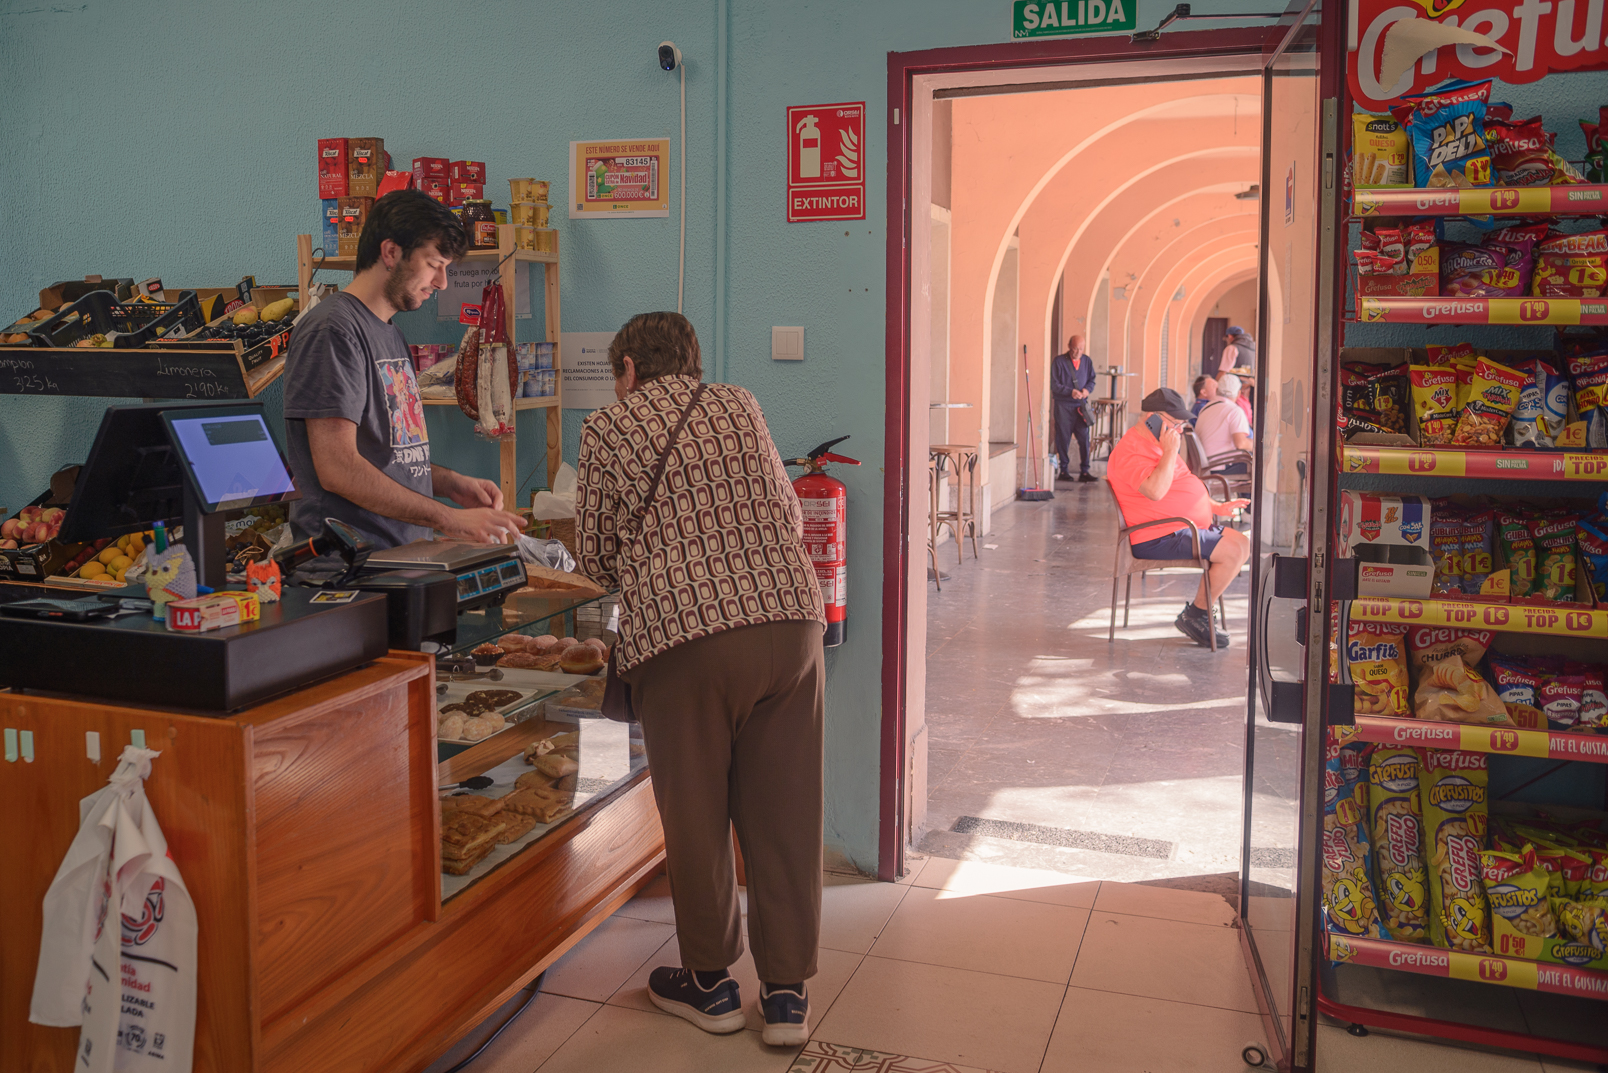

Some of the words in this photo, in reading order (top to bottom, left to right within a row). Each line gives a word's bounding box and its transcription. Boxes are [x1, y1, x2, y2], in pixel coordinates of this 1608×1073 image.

[1023, 0, 1126, 30] SALIDA
[1358, 0, 1608, 101] Grefu
[1421, 88, 1487, 116] Grefusa
[599, 145, 620, 154] NÚMERO
[621, 145, 627, 153] SE
[629, 144, 646, 153] VENDE
[647, 143, 660, 152] AQUÍ
[1369, 139, 1396, 148] QUESO
[625, 158, 649, 166] 83145
[620, 173, 647, 184] Navidad
[794, 195, 858, 210] EXTINTOR
[1569, 191, 1583, 200] SIN
[1482, 227, 1537, 243] refusa
[1541, 234, 1607, 254] M-BEAR
[448, 269, 458, 277] Se
[460, 269, 480, 277] ruega
[1575, 268, 1601, 283] 1€
[454, 280, 470, 288] fruta
[471, 281, 483, 289] por
[1364, 284, 1392, 293] Grefusa
[1422, 302, 1484, 319] Grefusa
[1580, 305, 1589, 314] IN
[1438, 348, 1470, 364] Grefusa
[157, 357, 217, 378] Limonera
[1422, 375, 1456, 387] Grefusa
[1484, 370, 1519, 387] Grefusa
[1433, 388, 1450, 399] MIX
[1487, 385, 1512, 398] MIX
[1440, 396, 1447, 407] 5
[1562, 427, 1582, 440] 1€
[1496, 459, 1511, 468] SIN
[1572, 461, 1608, 475] TOP
[1534, 520, 1576, 537] Grefusa
[1464, 541, 1484, 549] MIX
[1578, 539, 1603, 555] efusa
[1468, 554, 1489, 572] 1€
[1486, 577, 1505, 590] 1€
[1360, 603, 1392, 616] TOP
[1400, 602, 1420, 616] 1€
[1444, 609, 1477, 622] TOP
[1487, 608, 1507, 623] 1€
[176, 611, 192, 626] LA
[1525, 614, 1559, 628] TOP
[1568, 613, 1590, 629] 1€
[1414, 628, 1490, 648] Grefusa
[1369, 668, 1388, 677] QUESO
[1499, 674, 1536, 686] Grefusa
[1546, 684, 1582, 696] Grefusa
[1394, 726, 1453, 741] Grefusa
[1549, 738, 1566, 752] ATE
[1567, 740, 1578, 753] EL
[1580, 741, 1608, 757] GUSTA
[1388, 815, 1408, 865] GREFU
[1402, 816, 1419, 856] TUBO
[1448, 835, 1471, 890] GREFU
[1463, 837, 1482, 881] TUBO
[1389, 950, 1448, 967] Grefusa
[1562, 972, 1573, 988] EL
[1575, 974, 1608, 993] GUSTAZ
[121, 993, 155, 1010] LIZABLE
[121, 1004, 144, 1018] LADA
